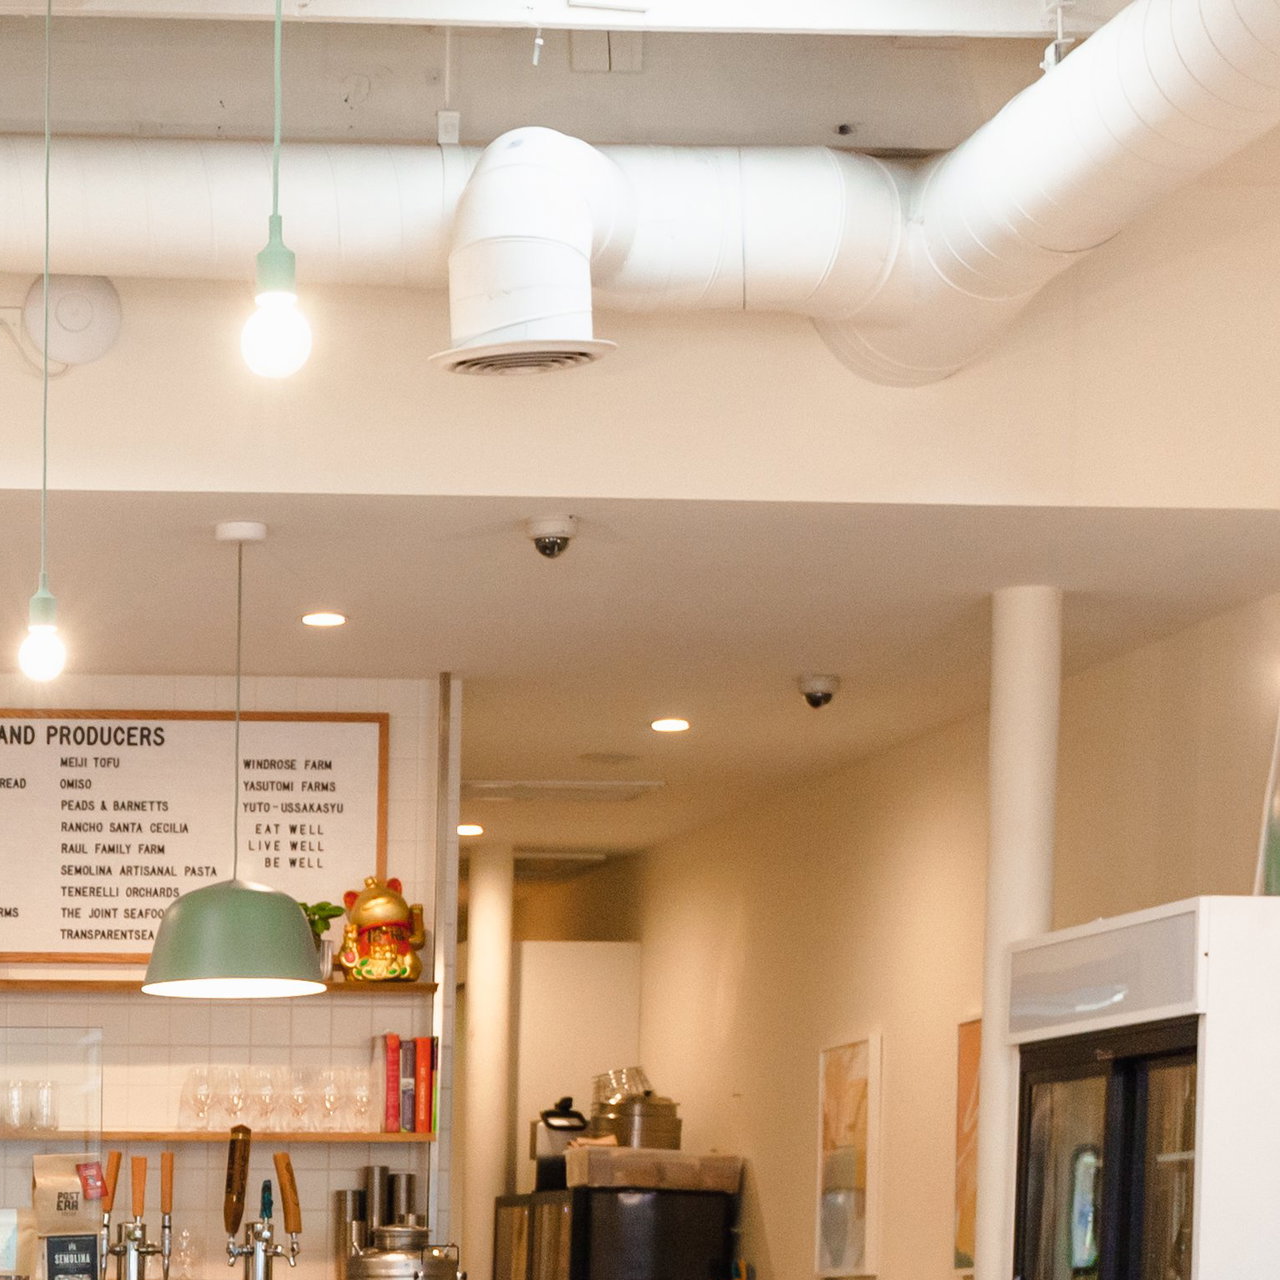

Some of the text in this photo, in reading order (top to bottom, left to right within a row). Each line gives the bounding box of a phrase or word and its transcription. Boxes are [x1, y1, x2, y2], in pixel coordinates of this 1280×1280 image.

[46, 725, 165, 746] PRODUCERS
[59, 756, 119, 768] MEIJI TOFU
[243, 759, 332, 770] WINDROSE FARM
[59, 778, 91, 789] OMISO
[243, 780, 335, 791] YASUTOMI FARMS
[60, 799, 168, 811] PEADS BARNETTS
[60, 821, 188, 833] RANCHO SANTA CECILIA
[255, 823, 323, 835] EAT WELL
[61, 843, 164, 854] RAUL FAMILY FARM
[248, 840, 323, 851] LIVE WELL
[264, 857, 322, 868] BE WELL
[60, 865, 216, 876] SEMOLINA ARTISANAL PASTA
[60, 886, 179, 897] TENERELLI ORCHARDS
[61, 907, 165, 919] THE JOINT SEAFOO
[60, 928, 153, 940] TRANSPARENTSEA
[57, 1191, 80, 1201] POST
[56, 1200, 79, 1211] ERA
[54, 1253, 90, 1264] SEMOLINA
